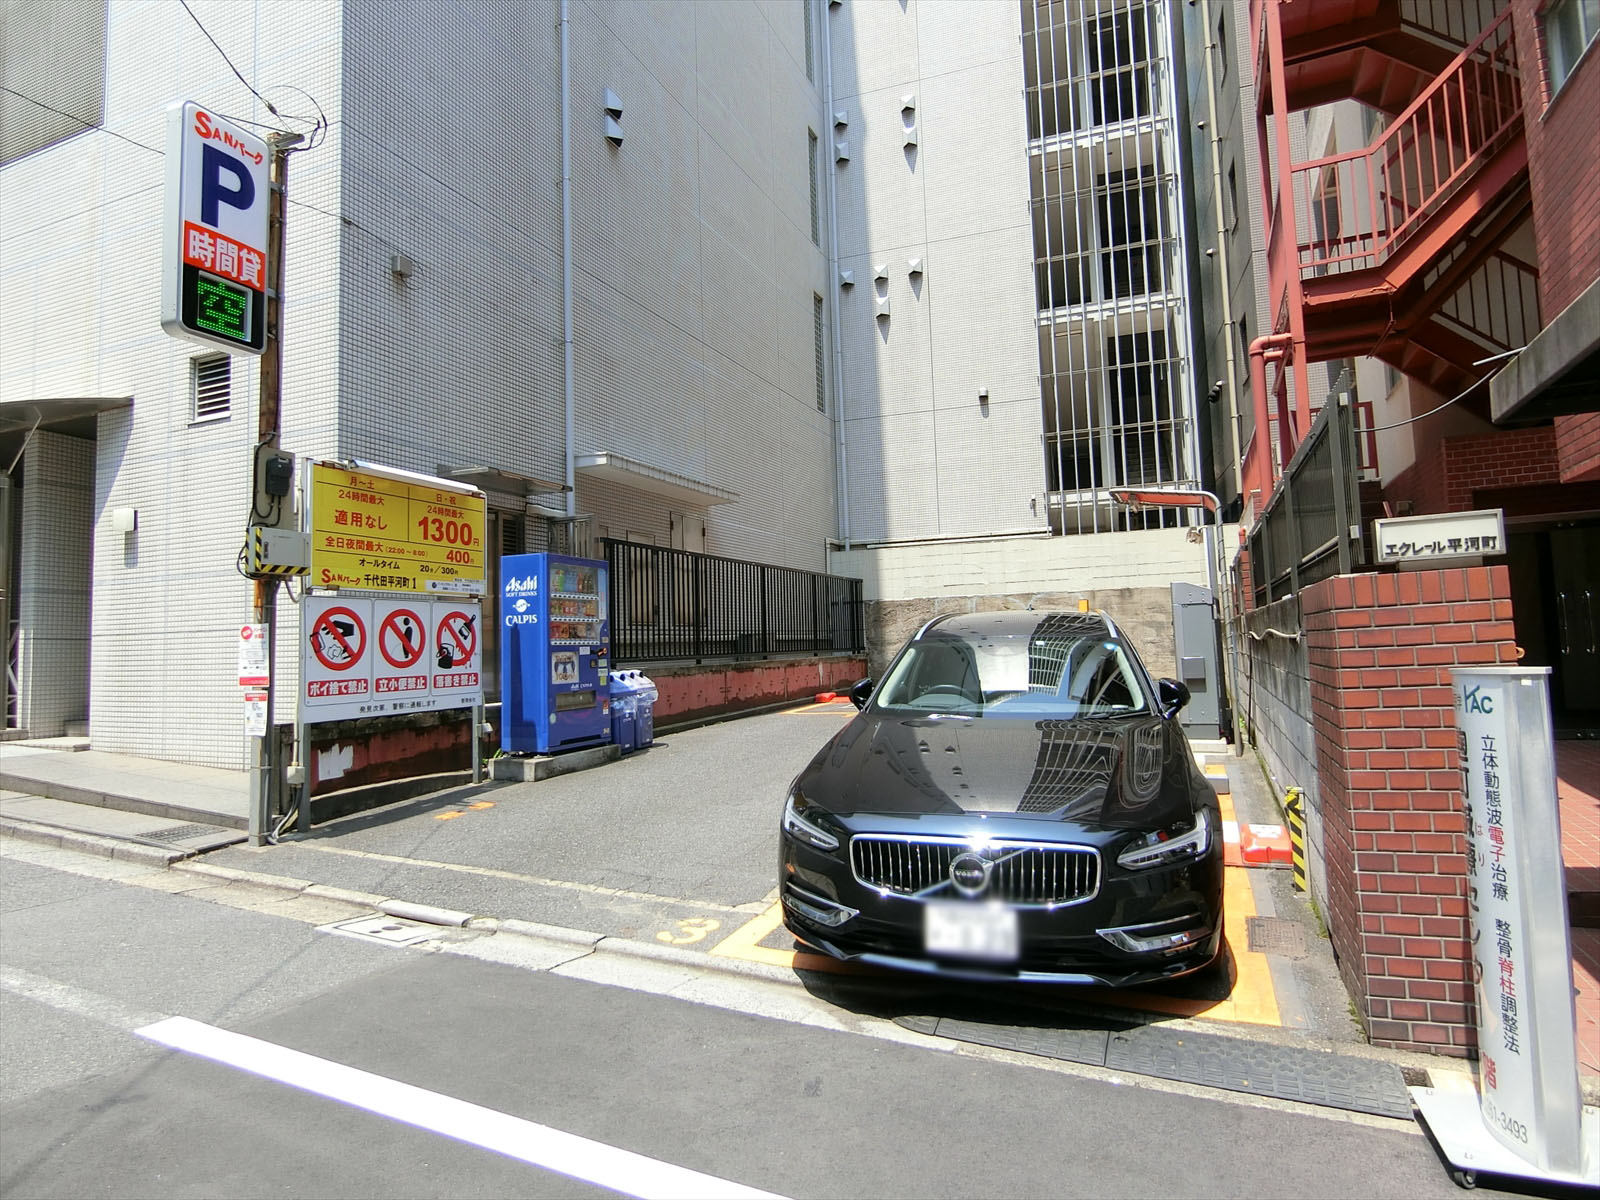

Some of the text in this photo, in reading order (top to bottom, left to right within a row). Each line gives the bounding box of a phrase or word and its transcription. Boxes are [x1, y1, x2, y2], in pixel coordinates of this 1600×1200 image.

[200, 142, 255, 228] P
[188, 229, 262, 288] 時間貸
[197, 282, 246, 339] 空
[338, 489, 385, 506] 24時間最大
[334, 508, 388, 531] 適用なし
[427, 505, 465, 520] 24時間最大
[418, 515, 480, 547] 1300円
[325, 535, 384, 553] 全日夜間最大
[1385, 536, 1497, 556] エクレール平河町
[359, 557, 400, 570] オールタイム
[505, 575, 538, 593] Asahi
[505, 614, 538, 627] CALPIS
[309, 680, 368, 696] ポイ捨て禁止
[378, 676, 426, 691] 立小便禁止
[436, 674, 476, 688] 落書き禁止
[1481, 734, 1509, 902] 立体動態波電子治療
[656, 918, 720, 944] 3
